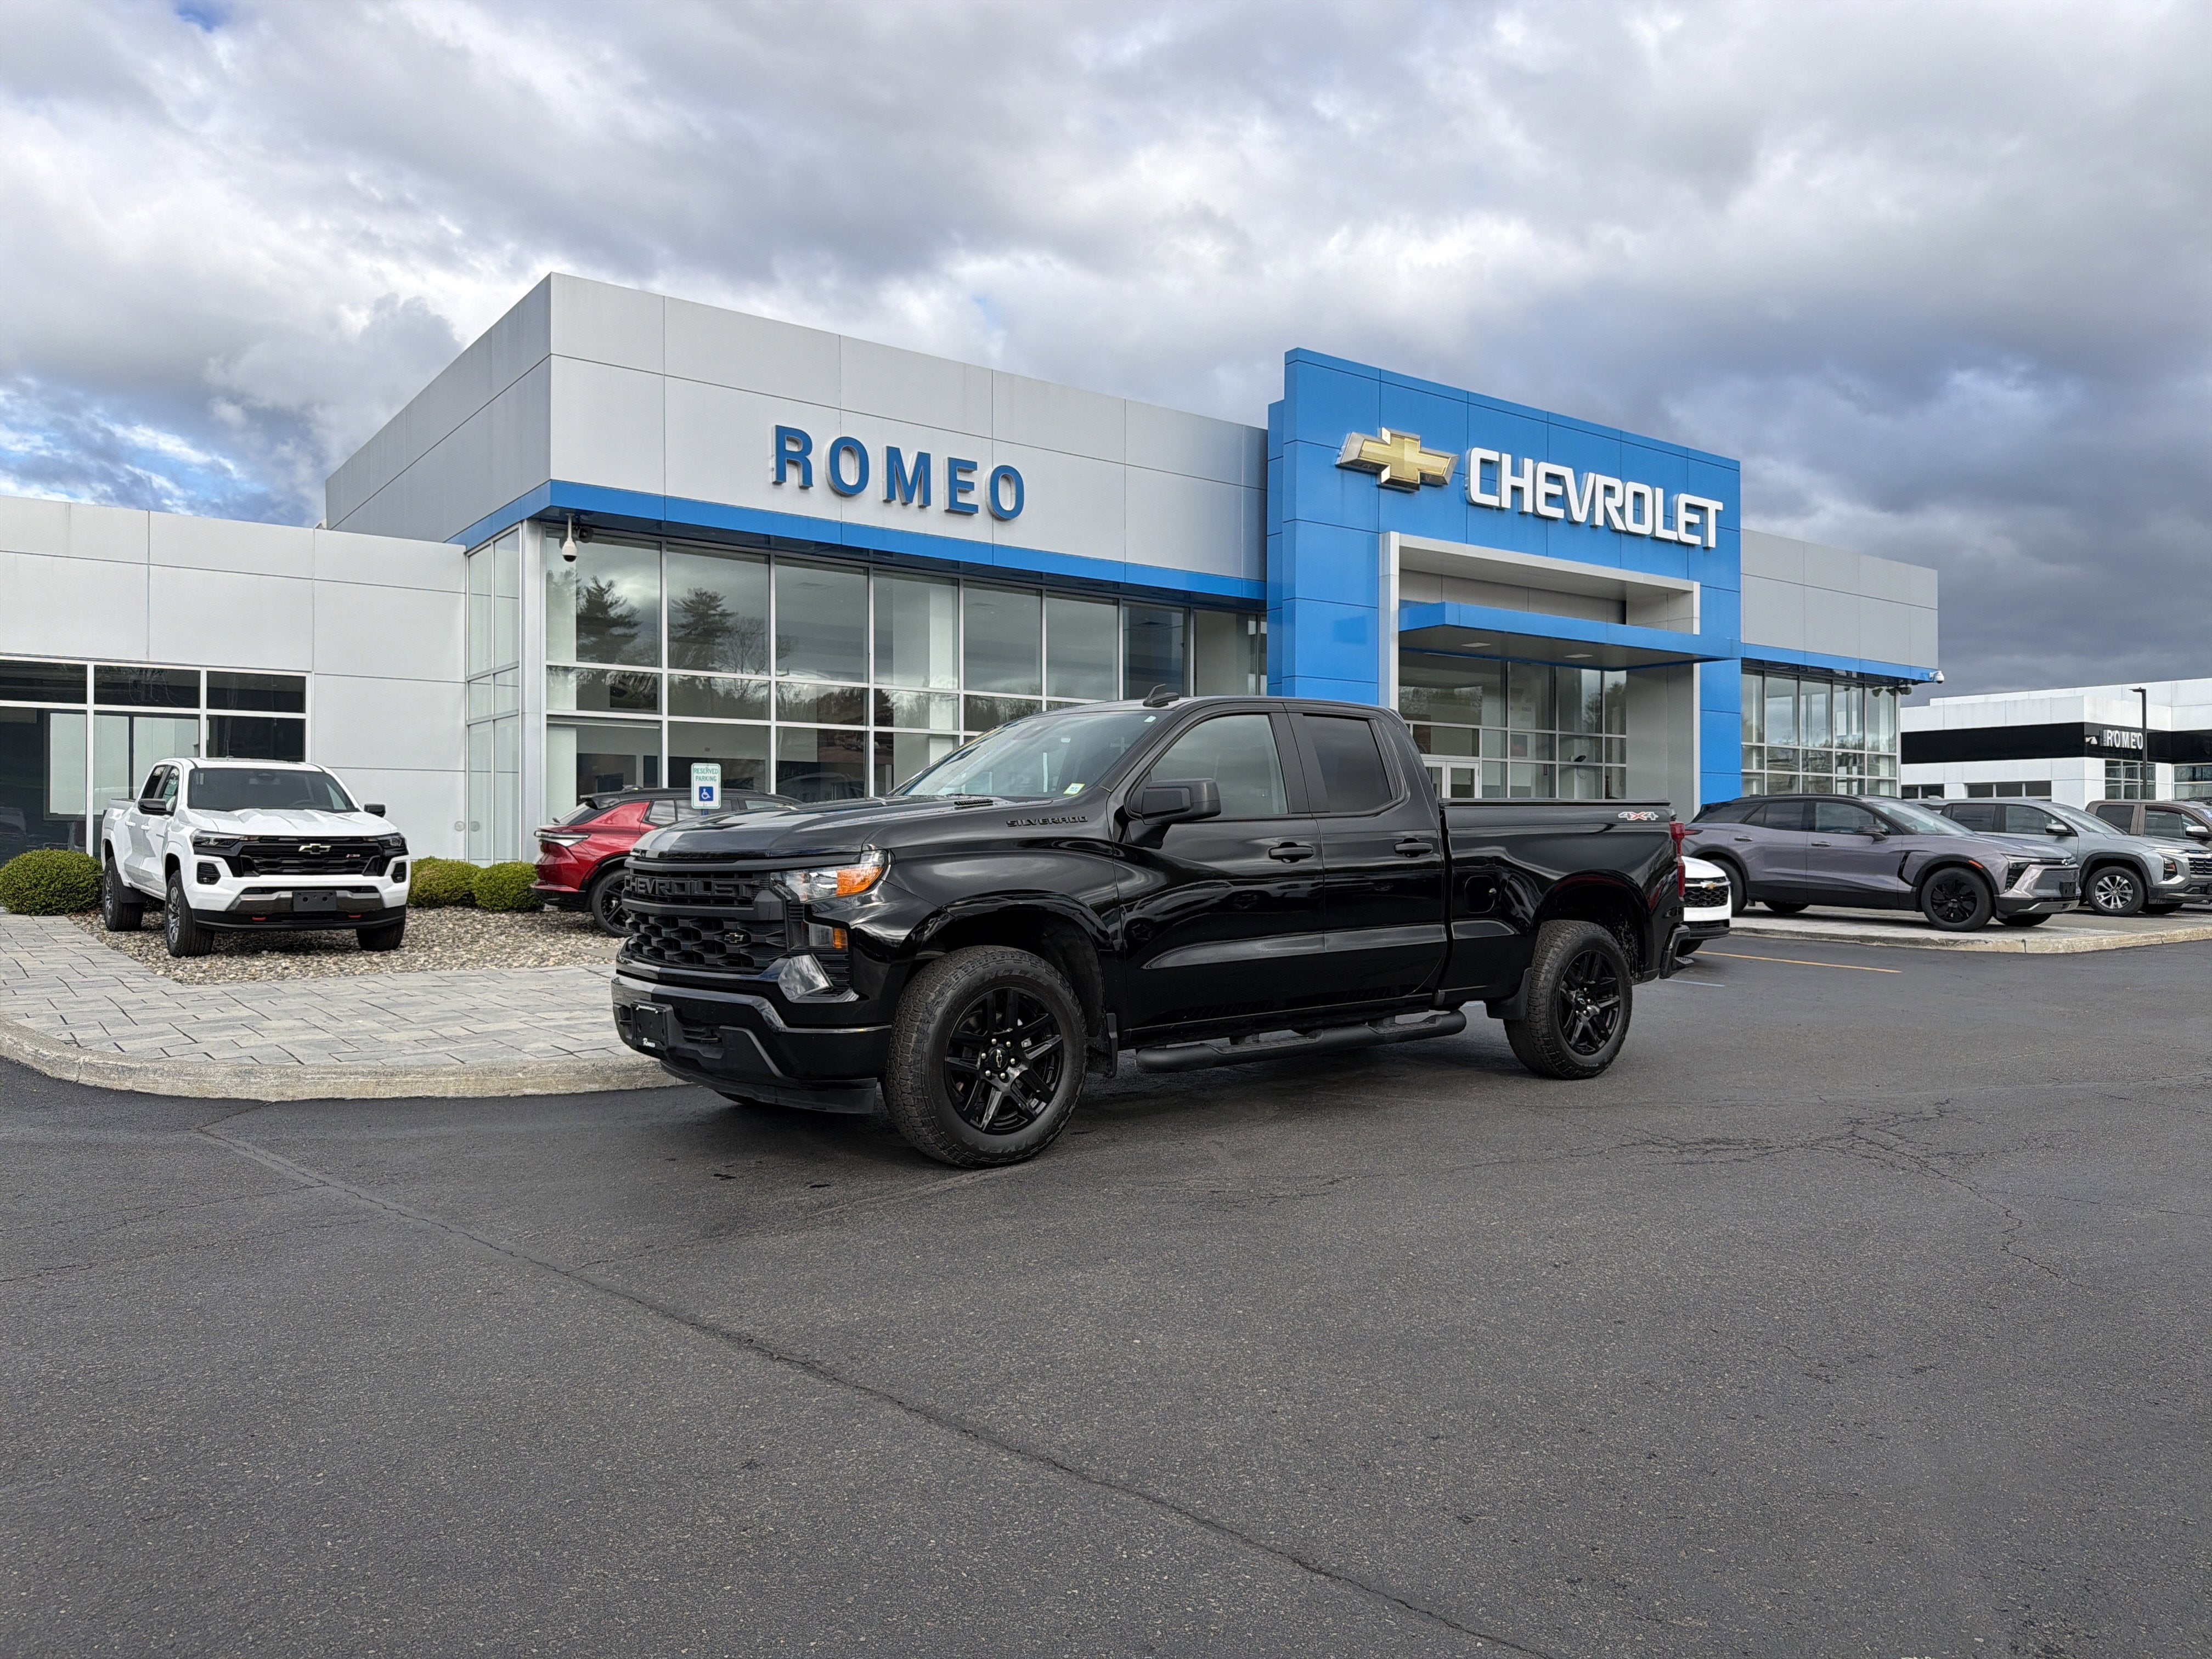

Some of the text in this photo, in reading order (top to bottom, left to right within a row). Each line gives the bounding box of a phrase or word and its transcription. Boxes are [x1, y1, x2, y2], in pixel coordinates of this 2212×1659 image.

[771, 425, 1025, 521] ROMEO
[1465, 447, 1724, 549] CHEVROLET
[2106, 729, 2143, 749] ROMEO
[1006, 816, 1088, 827] SILVERADO
[624, 876, 754, 898] CHEVROLET
